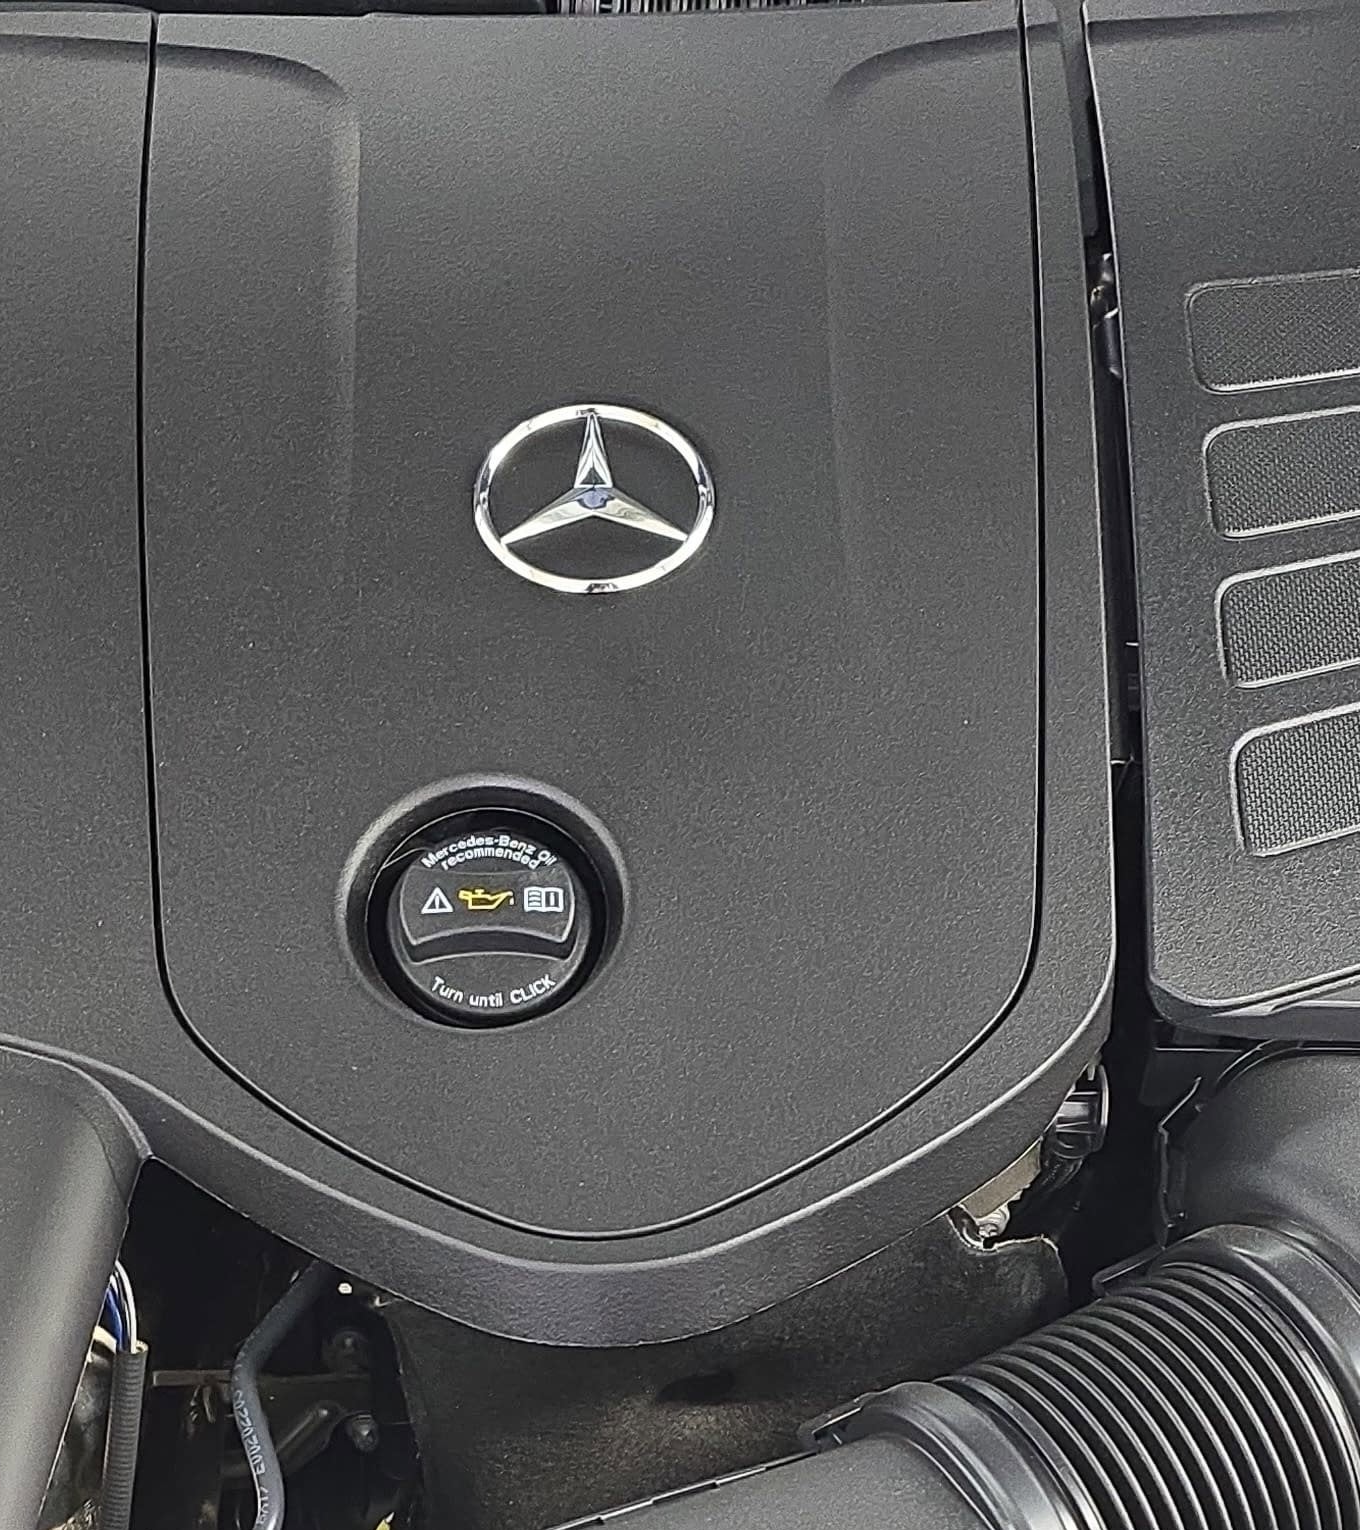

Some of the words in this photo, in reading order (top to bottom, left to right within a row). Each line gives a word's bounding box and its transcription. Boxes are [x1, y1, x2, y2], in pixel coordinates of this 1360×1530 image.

[421, 835, 536, 869] Mercedes-Benz
[538, 848, 556, 866] Oil
[442, 847, 541, 870] recommended
[432, 976, 464, 1003] Turn
[470, 989, 503, 1007] until
[511, 975, 556, 1003] CLICK
